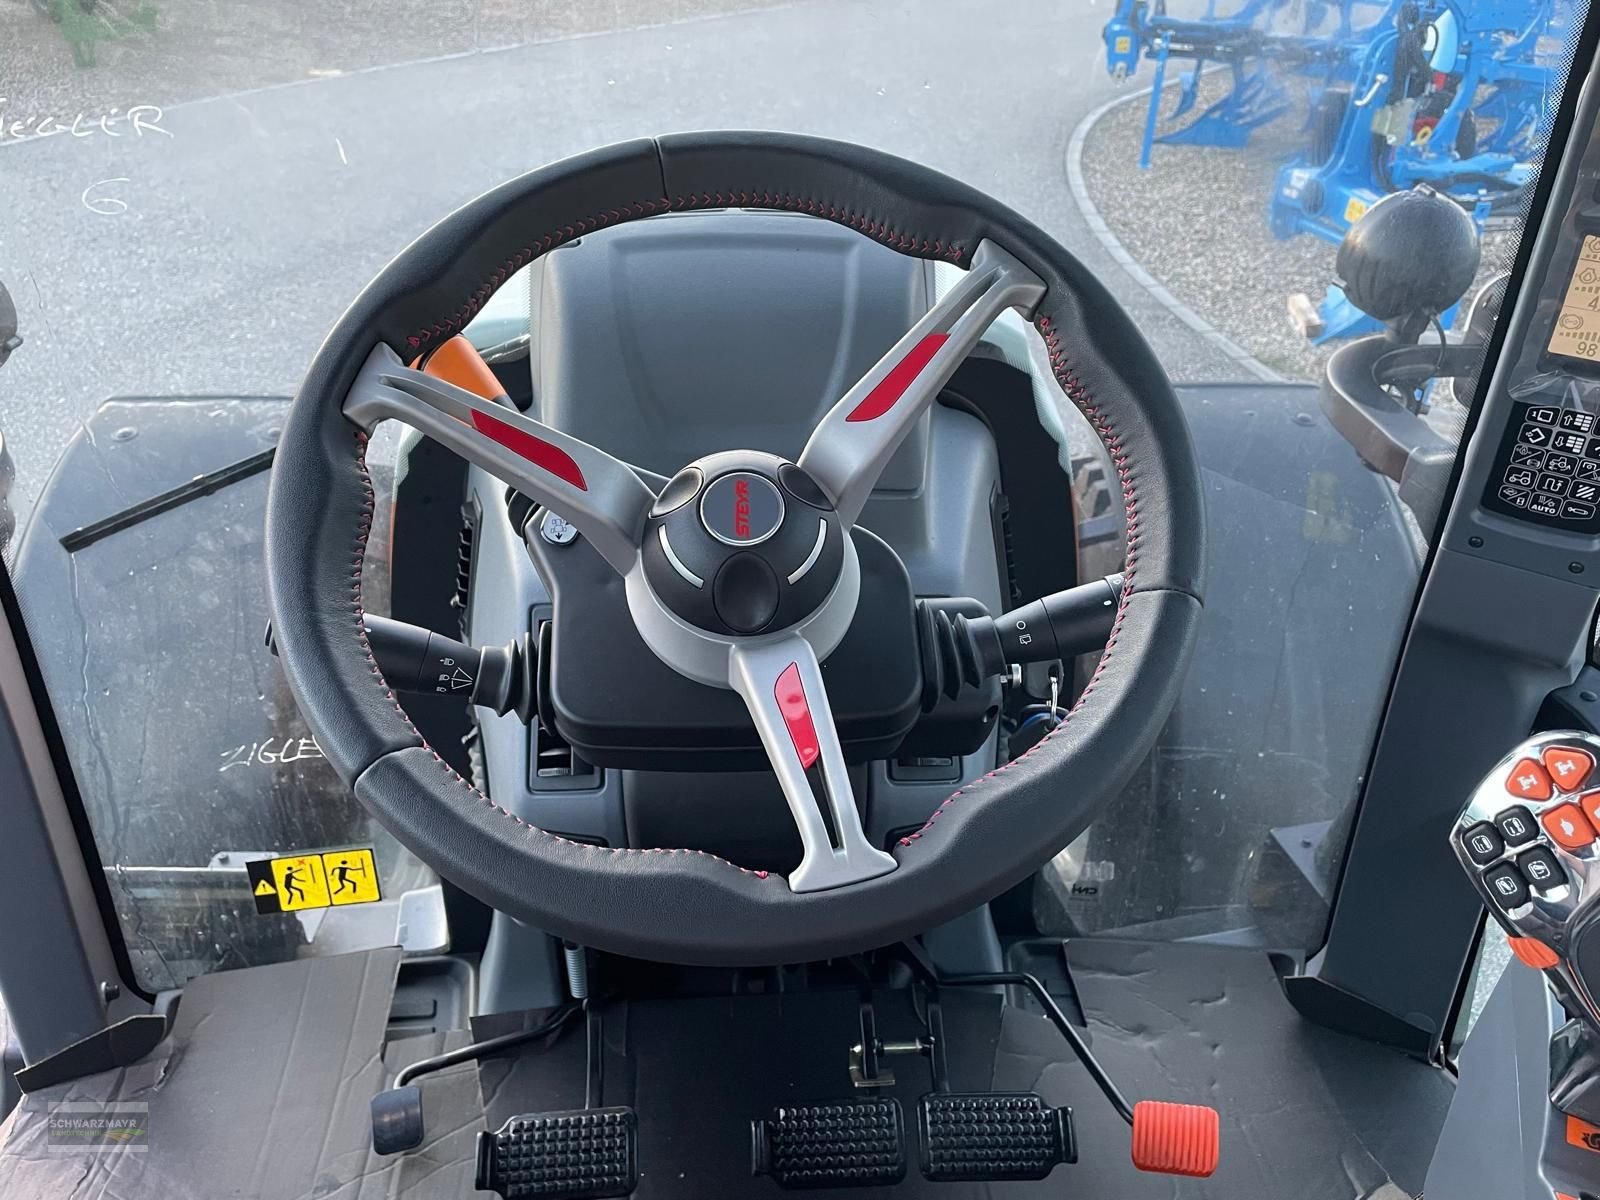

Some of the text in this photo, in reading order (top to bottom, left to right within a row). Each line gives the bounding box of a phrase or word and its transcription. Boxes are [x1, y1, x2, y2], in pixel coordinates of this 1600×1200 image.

[1576, 341, 1598, 357] 98
[735, 479, 750, 539] STEYR
[1531, 504, 1556, 514] AUTO
[219, 737, 324, 771] ZIGLE
